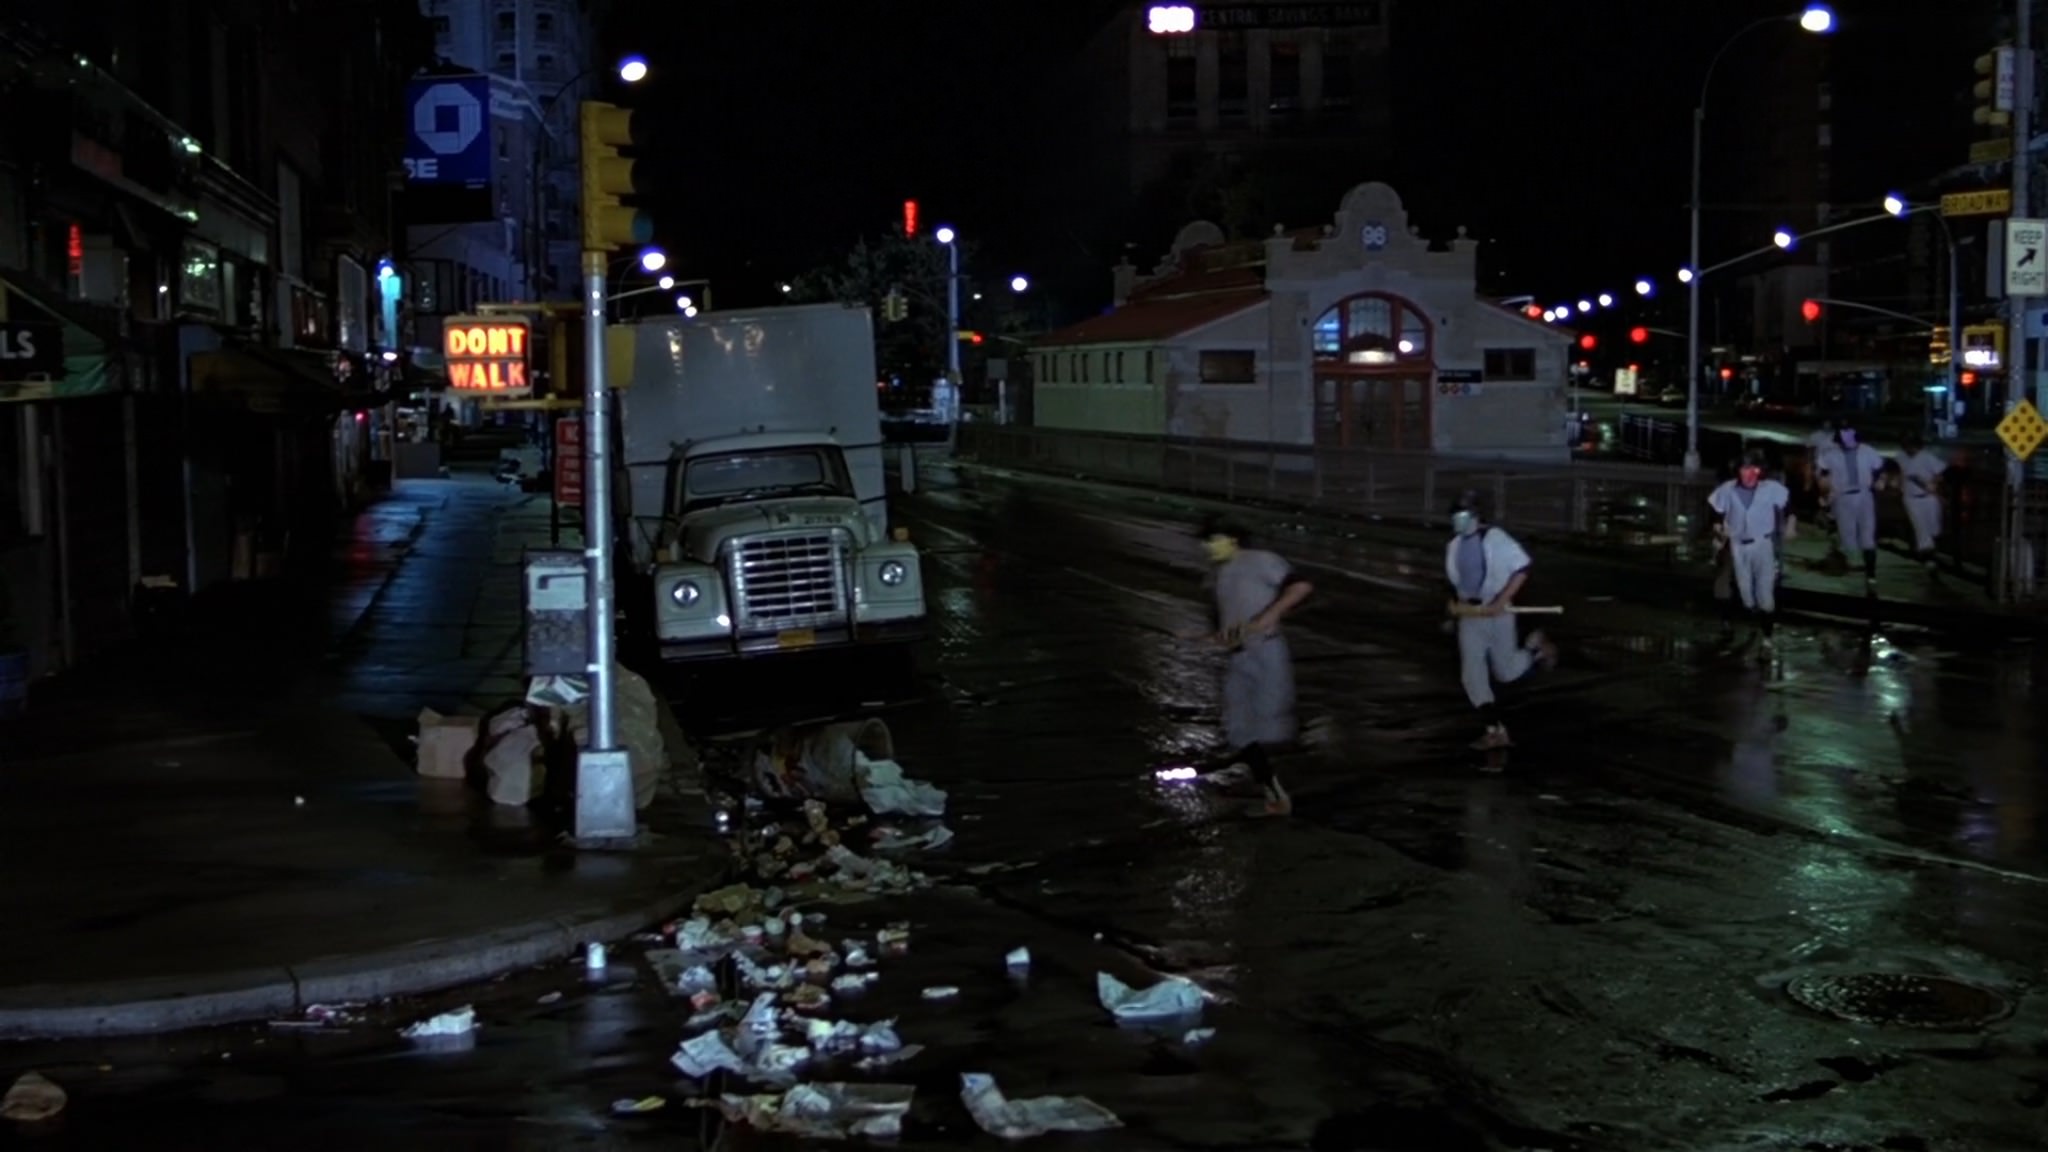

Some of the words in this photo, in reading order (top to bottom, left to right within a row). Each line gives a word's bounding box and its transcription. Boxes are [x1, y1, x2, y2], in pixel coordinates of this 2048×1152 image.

[1942, 190, 2010, 213] BROADWAY
[2013, 230, 2043, 245] KEEP
[2011, 271, 2045, 287] RIGHT
[0, 329, 37, 361] LS
[448, 326, 526, 356] DONT
[448, 361, 526, 389] WALK
